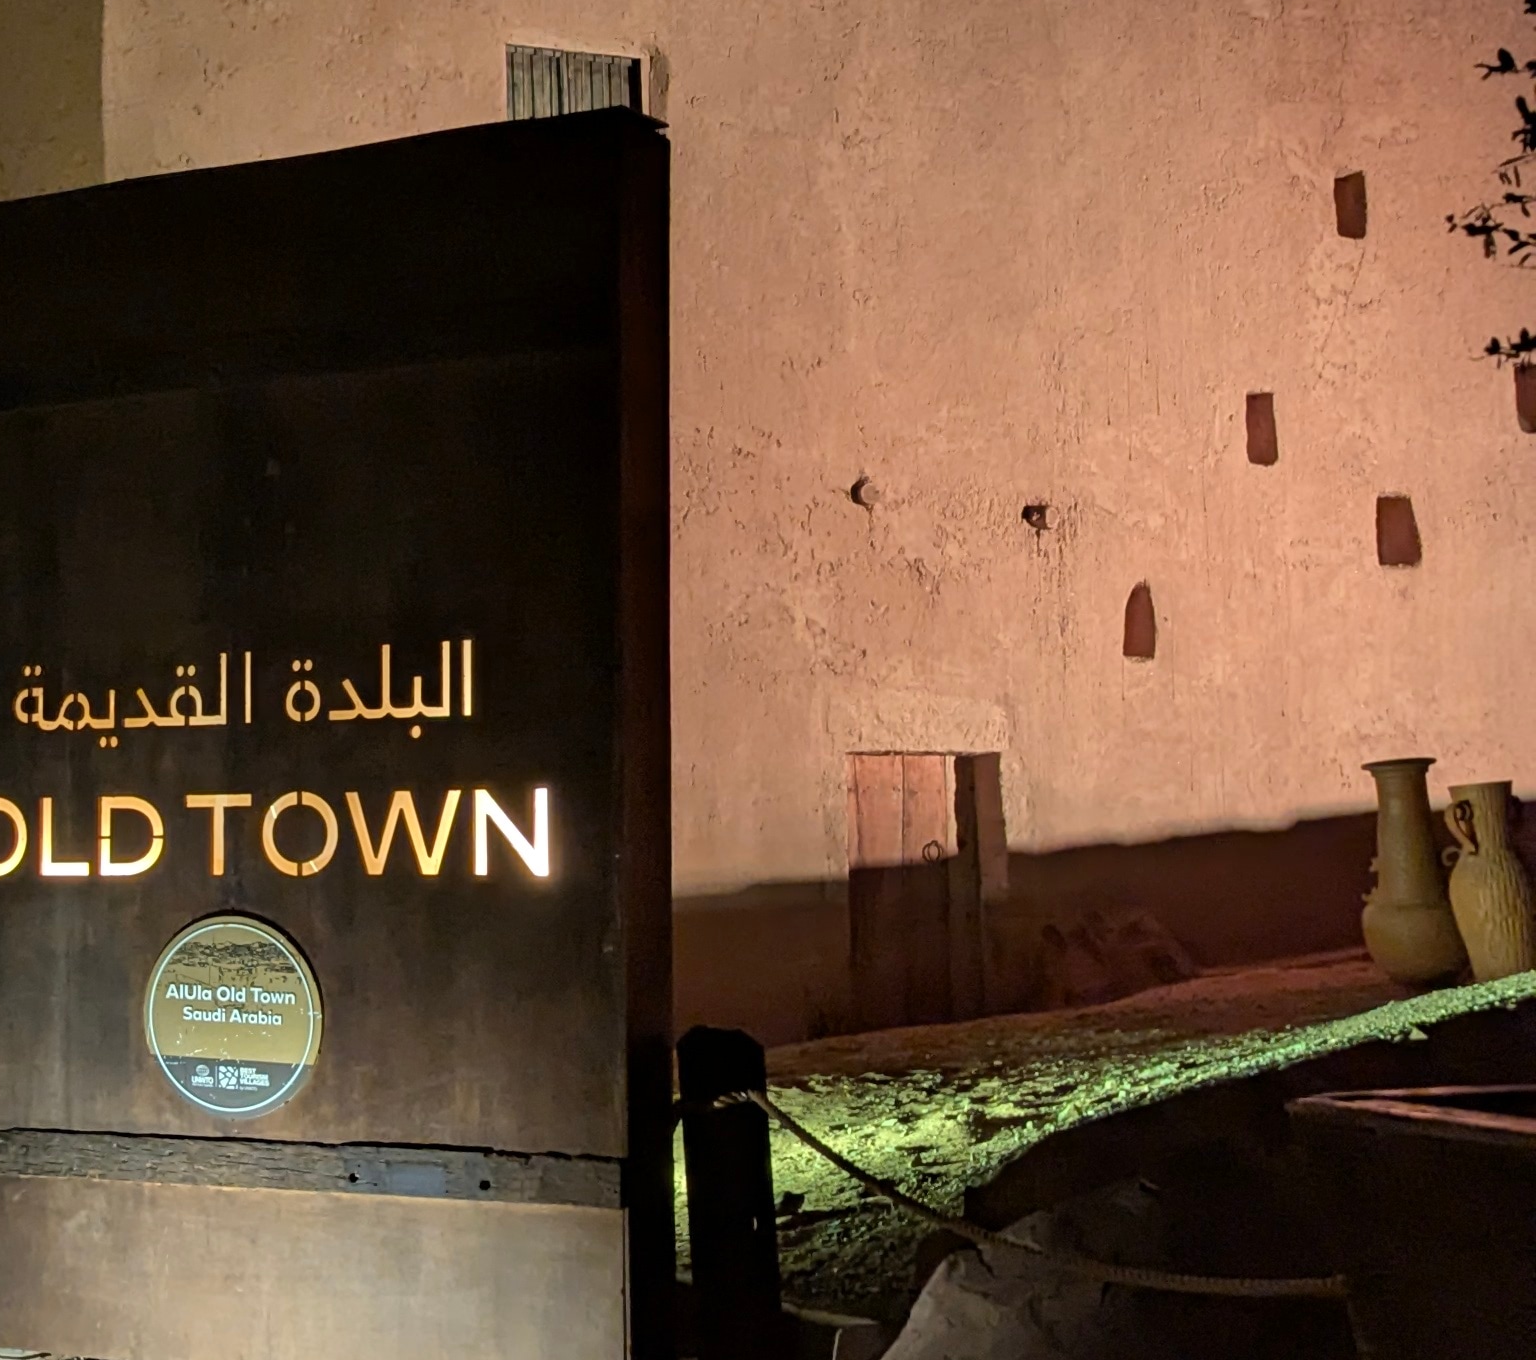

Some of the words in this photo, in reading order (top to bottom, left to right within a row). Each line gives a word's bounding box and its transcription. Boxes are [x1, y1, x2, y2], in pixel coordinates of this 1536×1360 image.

[15, 652, 252, 748] القديمة
[286, 640, 472, 739] البلدة
[186, 787, 553, 881] TOWN
[166, 983, 213, 1001] AlUla
[216, 986, 246, 1003] Old
[250, 987, 296, 1005] Town
[183, 1006, 226, 1022] Saudi
[229, 1009, 282, 1026] Arabia
